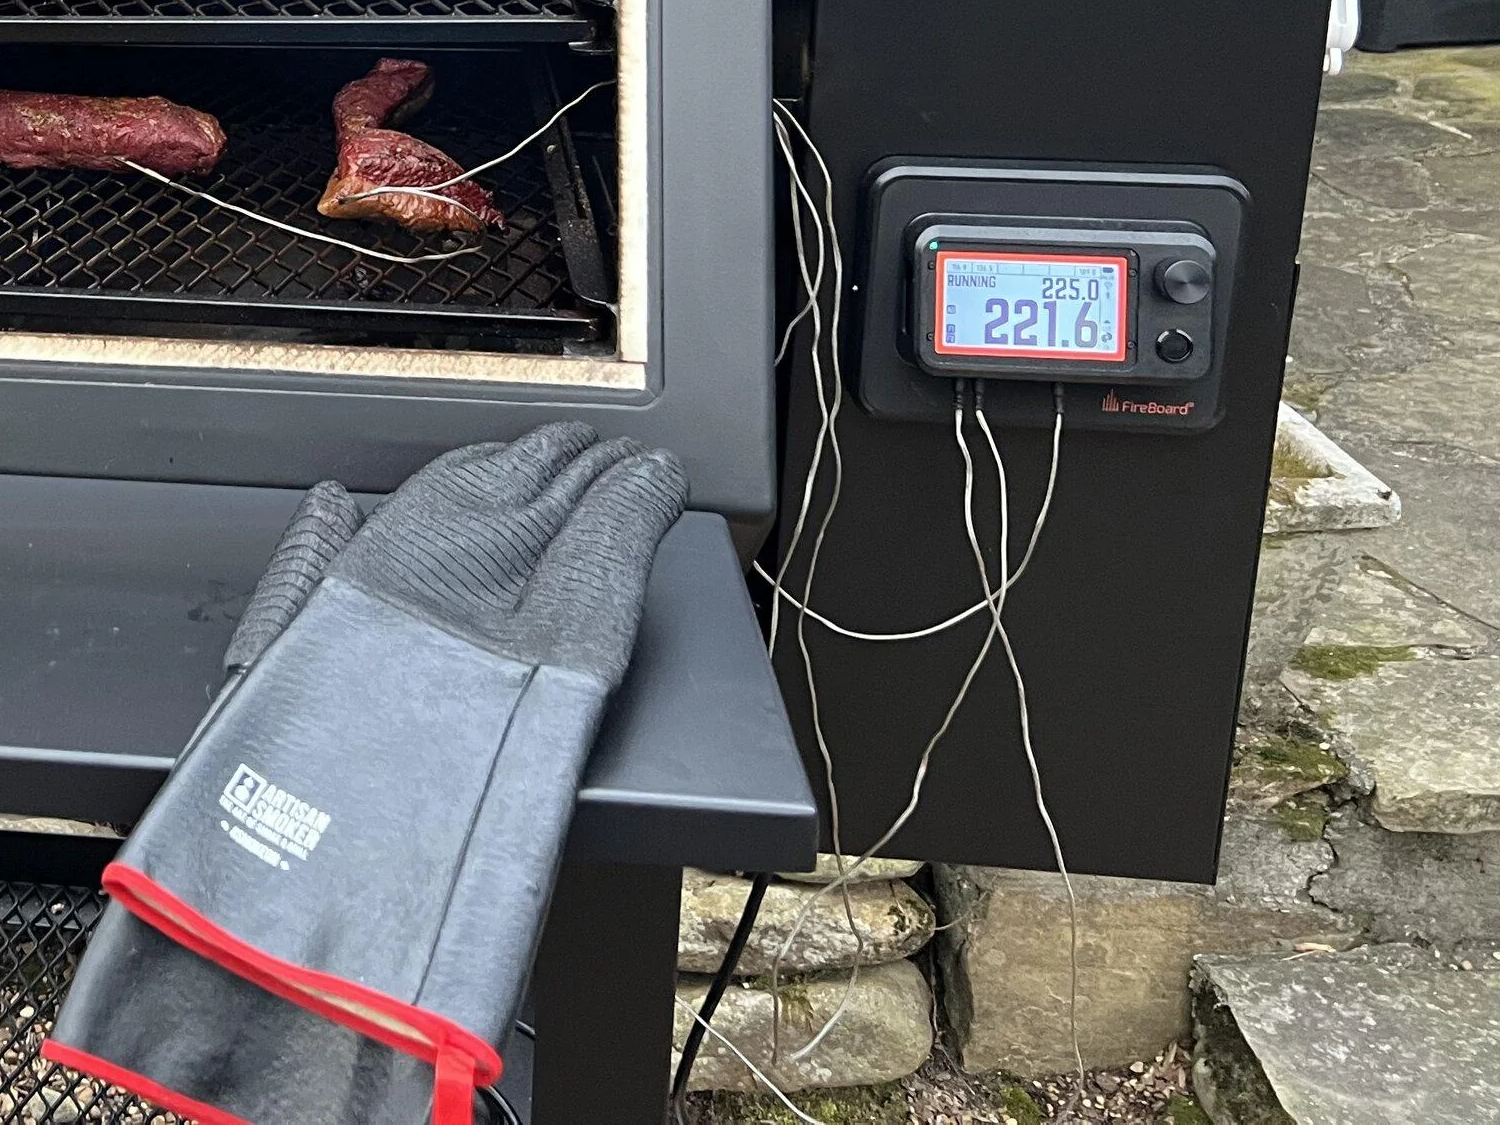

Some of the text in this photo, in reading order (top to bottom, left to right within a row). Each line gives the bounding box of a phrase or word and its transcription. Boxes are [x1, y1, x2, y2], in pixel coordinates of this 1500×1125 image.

[947, 274, 996, 288] RUNNING
[1042, 277, 1099, 301] 225.0
[984, 298, 1098, 348] 221.6
[252, 800, 321, 851] SMOKER
[261, 784, 332, 833] ARTISAN
